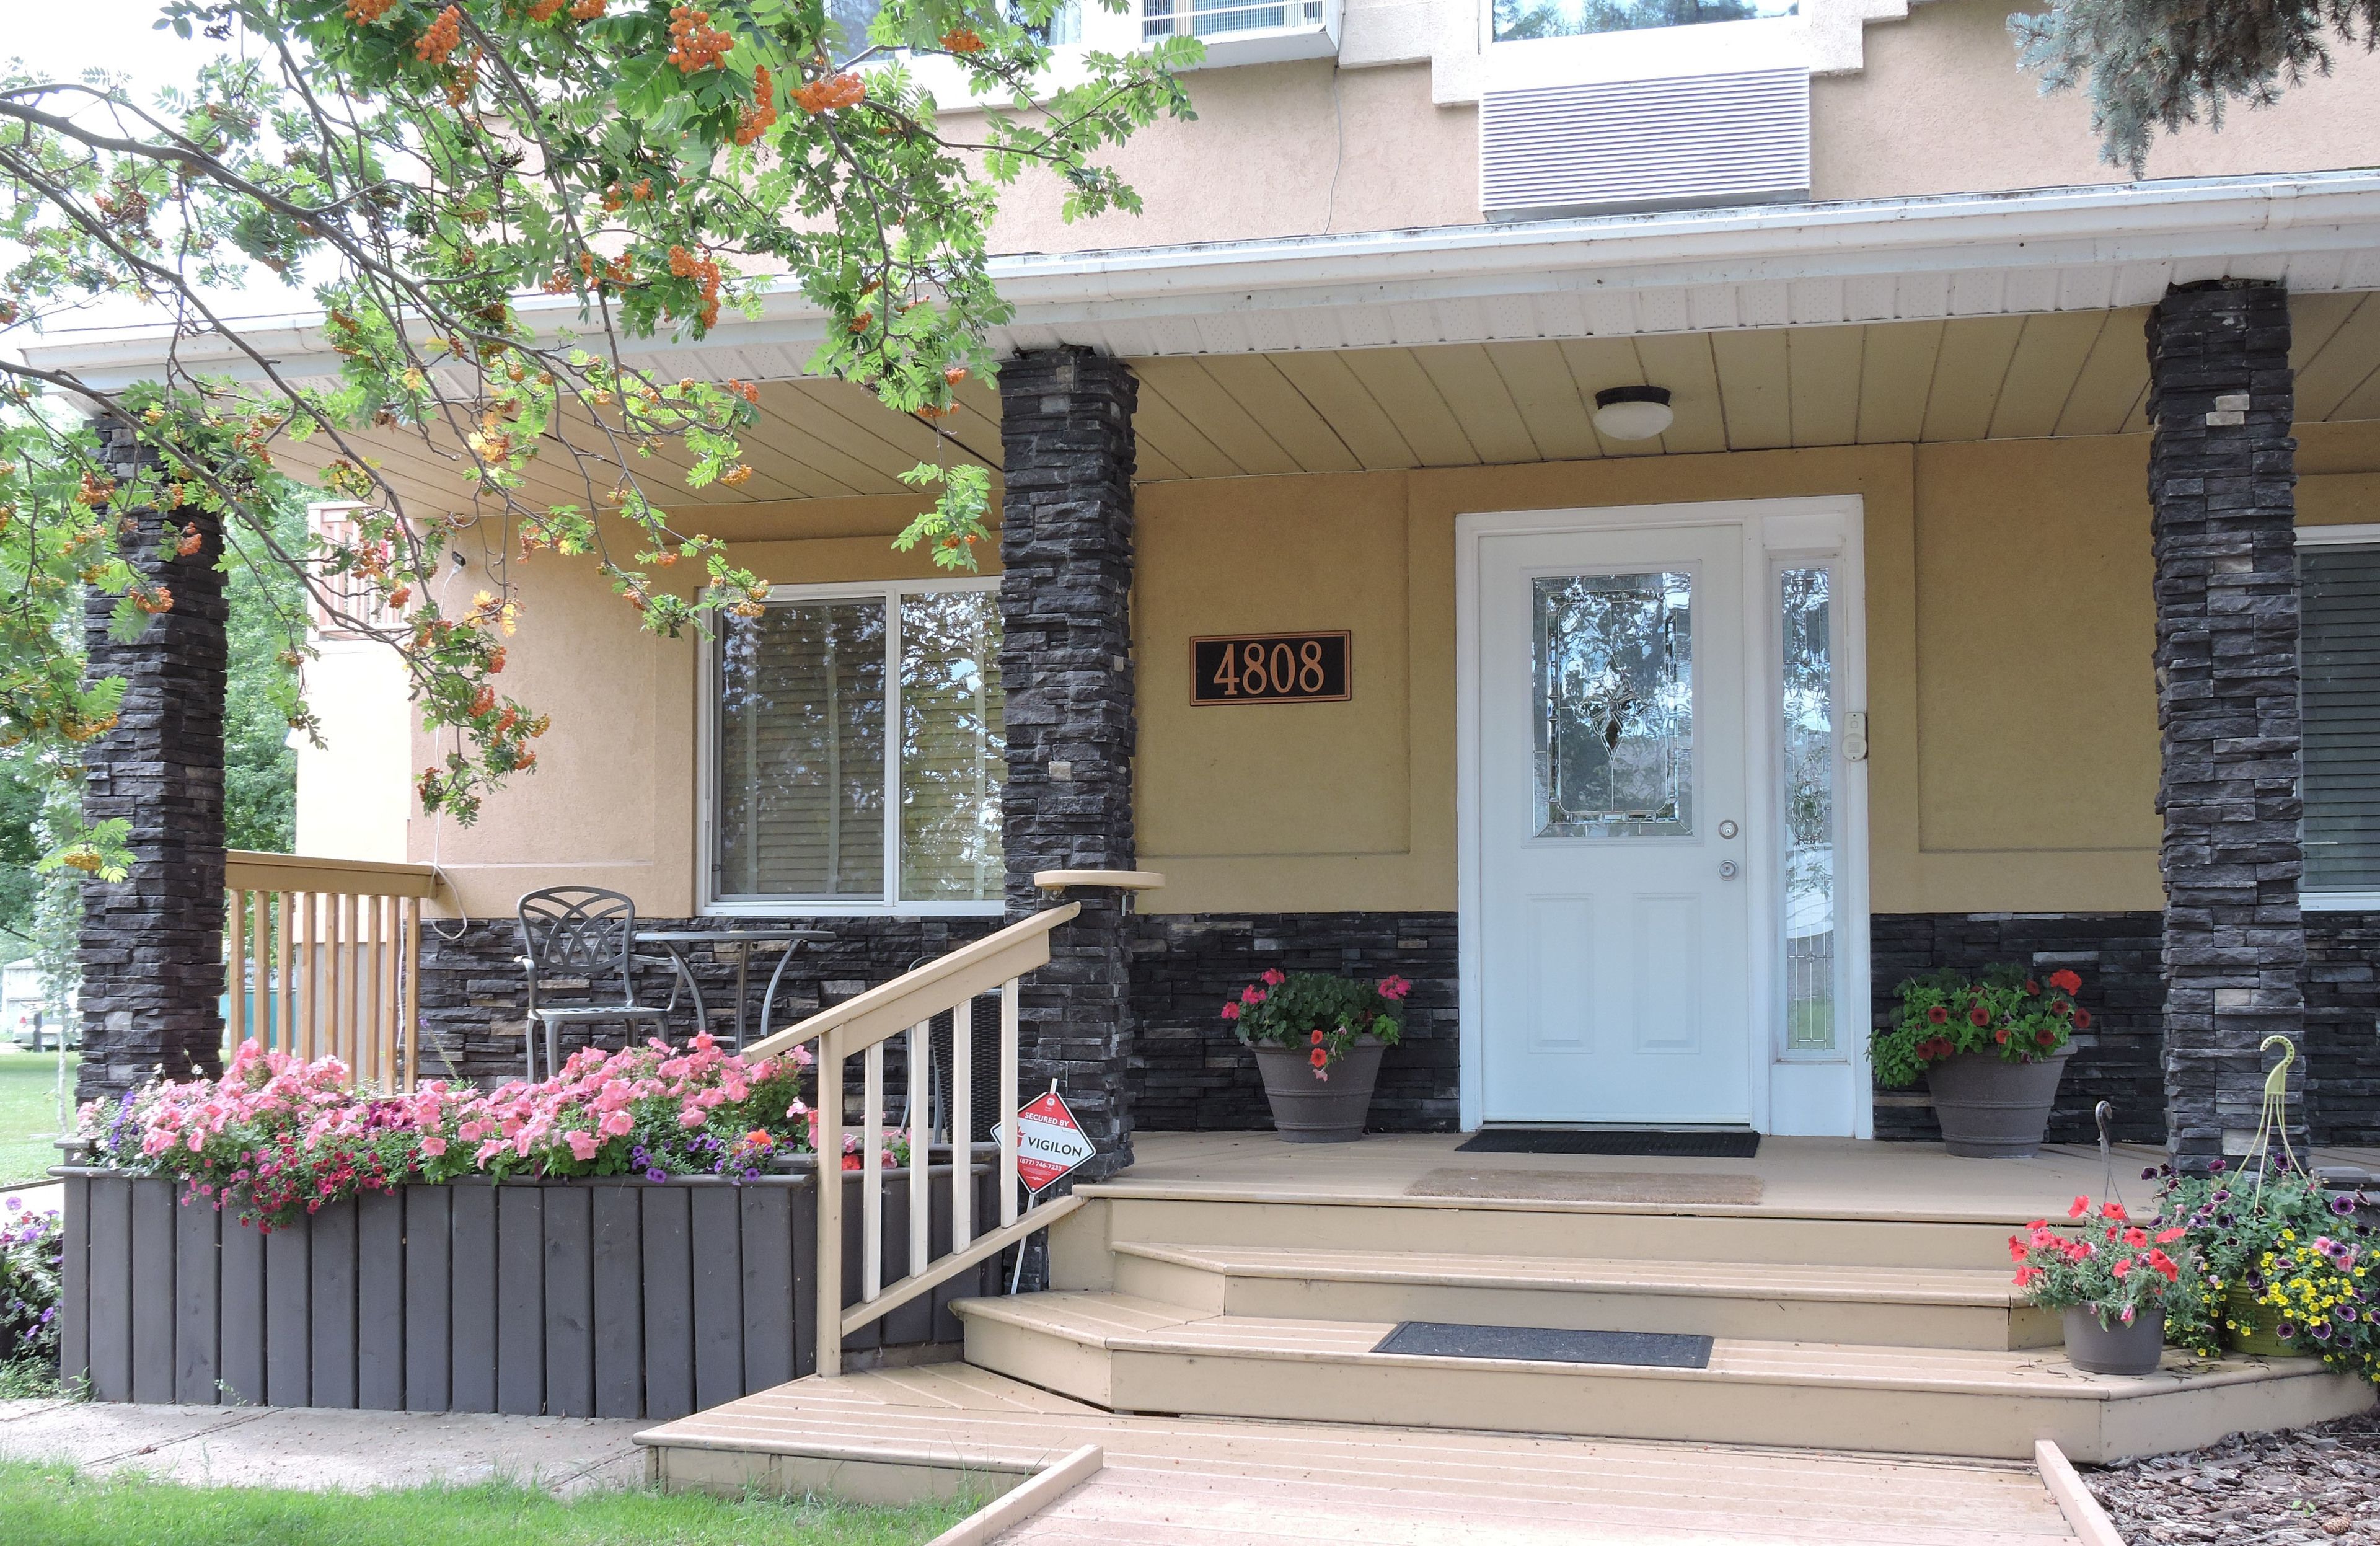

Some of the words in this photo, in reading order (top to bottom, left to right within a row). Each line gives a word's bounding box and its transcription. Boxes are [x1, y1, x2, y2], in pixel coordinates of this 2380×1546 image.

[1214, 640, 1324, 695] 4808
[1025, 1112, 1058, 1124] SECURED
[1028, 1136, 1082, 1157] VIGILON
[1036, 1161, 1062, 1172] 746-7233
